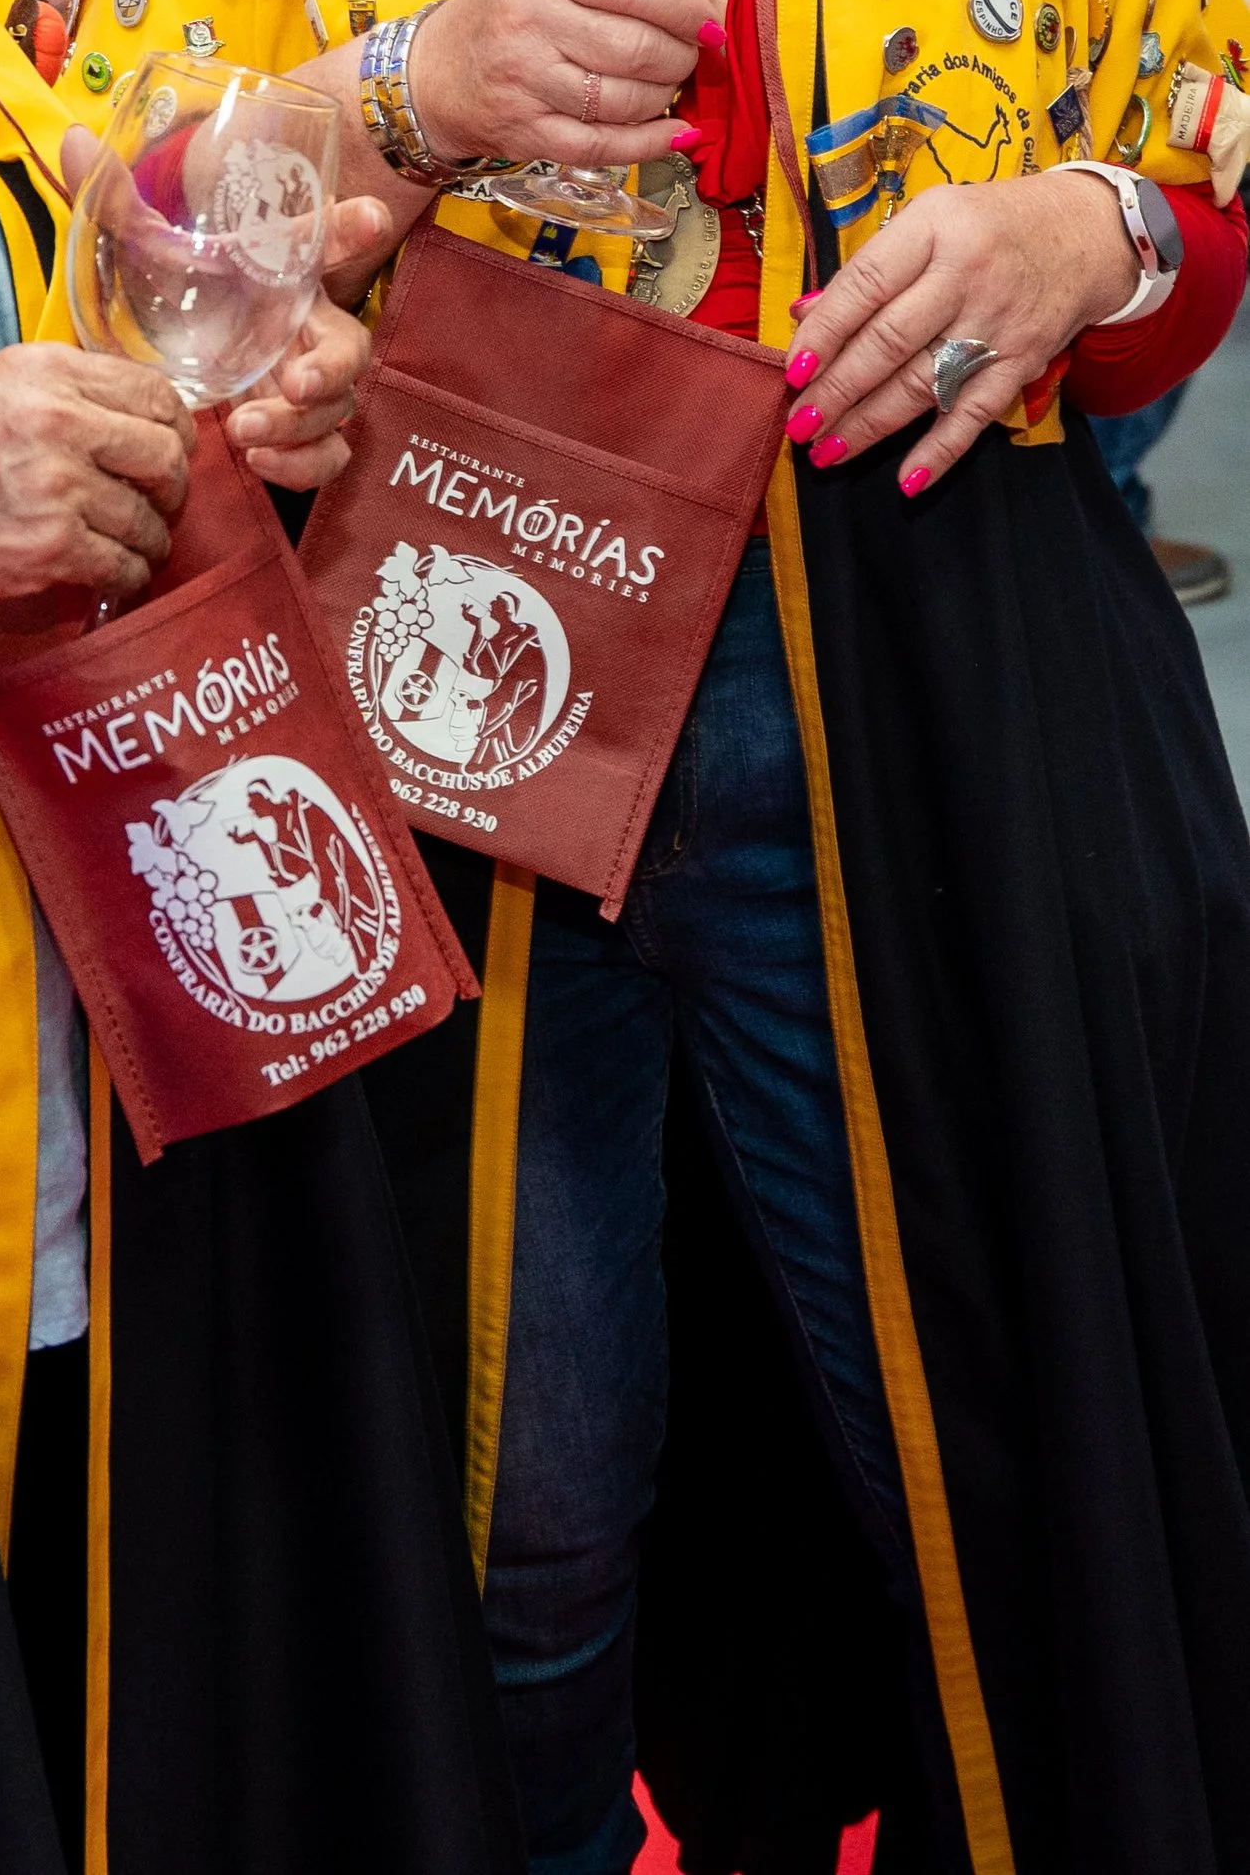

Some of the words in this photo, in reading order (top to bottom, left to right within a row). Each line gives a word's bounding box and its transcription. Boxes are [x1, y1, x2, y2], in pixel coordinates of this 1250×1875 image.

[975, 0, 1004, 36] ESPINHO
[943, 52, 969, 71] dos
[971, 55, 1017, 104] Amigos
[1016, 107, 1030, 132] da
[1178, 88, 1198, 141] MADEIRA
[704, 208, 718, 242] Guia
[410, 434, 526, 488] RESTAURANTE
[511, 542, 650, 604] MEMORIES
[41, 668, 178, 738] RESTAURANTE
[347, 605, 375, 724] CONFRARIA
[367, 723, 394, 753] DO
[388, 748, 484, 792] BACCHUS
[485, 771, 515, 790] DE
[518, 691, 594, 781] ALBUFEIRA
[389, 778, 423, 805] 962
[423, 792, 462, 819] 228
[461, 806, 498, 833] 930
[149, 908, 244, 1029] CONFRARIA
[246, 1010, 286, 1036] DO
[290, 959, 387, 1035] BACCHUS
[377, 933, 400, 972] DE
[260, 1053, 310, 1087] Tel:
[309, 1028, 350, 1065] 962
[350, 1005, 391, 1042] 228
[389, 983, 428, 1020] 930
